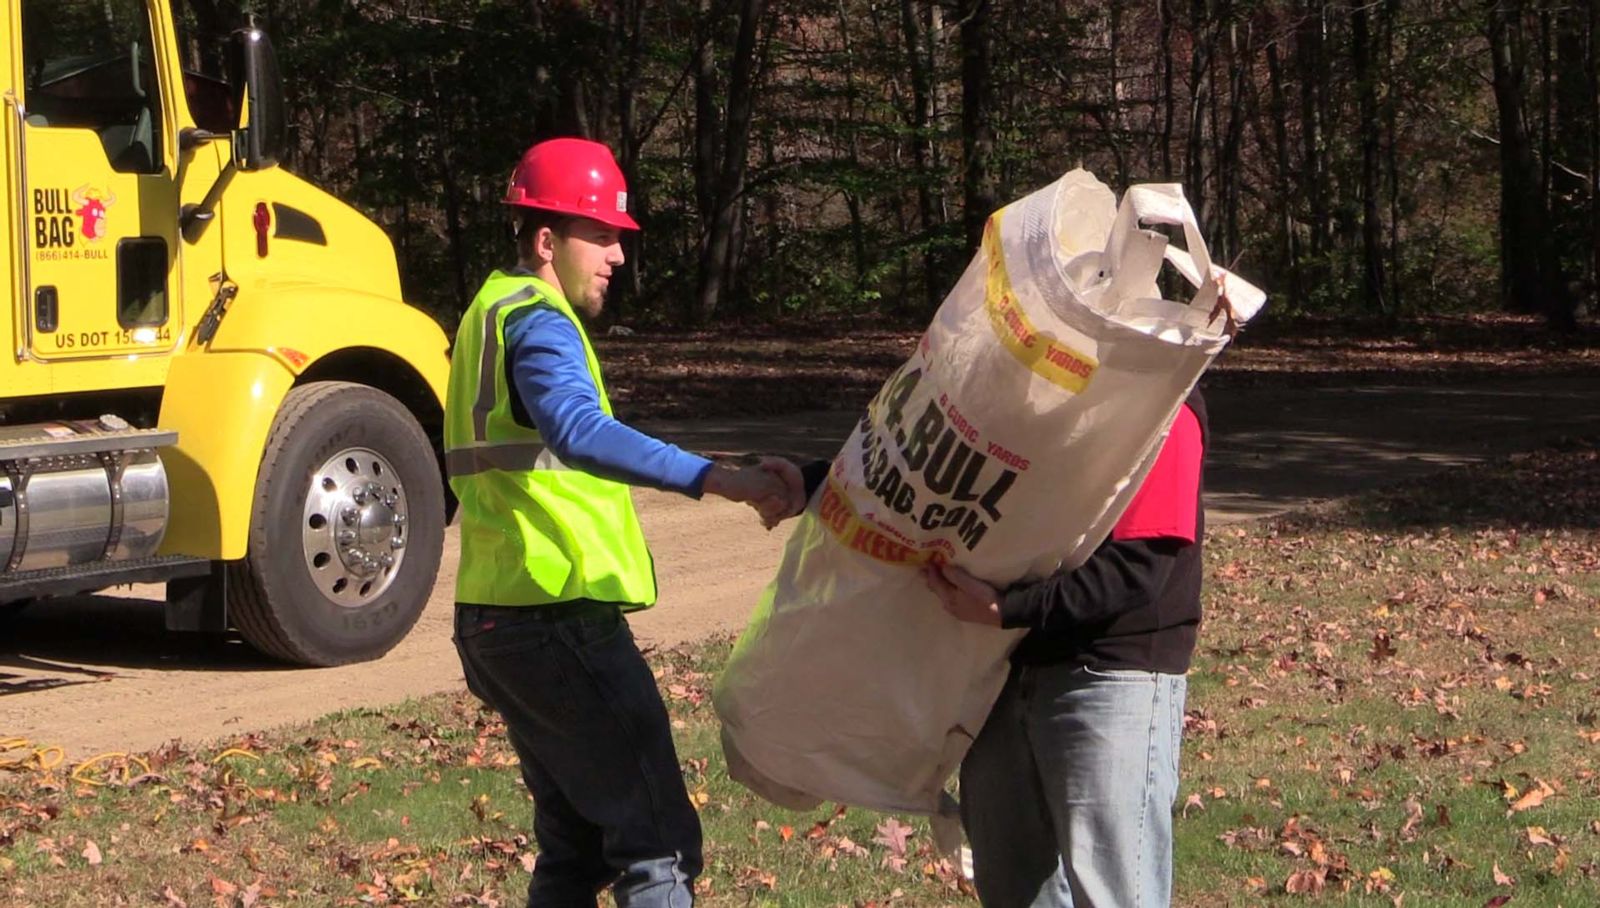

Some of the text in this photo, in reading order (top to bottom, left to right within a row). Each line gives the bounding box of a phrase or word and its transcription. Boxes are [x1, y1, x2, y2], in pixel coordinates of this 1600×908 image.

[34, 188, 73, 214] BULL
[35, 216, 75, 249] BAG
[35, 249, 109, 261] (866)414-BULL
[56, 327, 171, 348] US DOT 1544
[1004, 309, 1038, 349] CUBIC
[1045, 344, 1094, 379] YARDS
[947, 405, 980, 443] CUBIC
[987, 441, 1032, 472] YARDS
